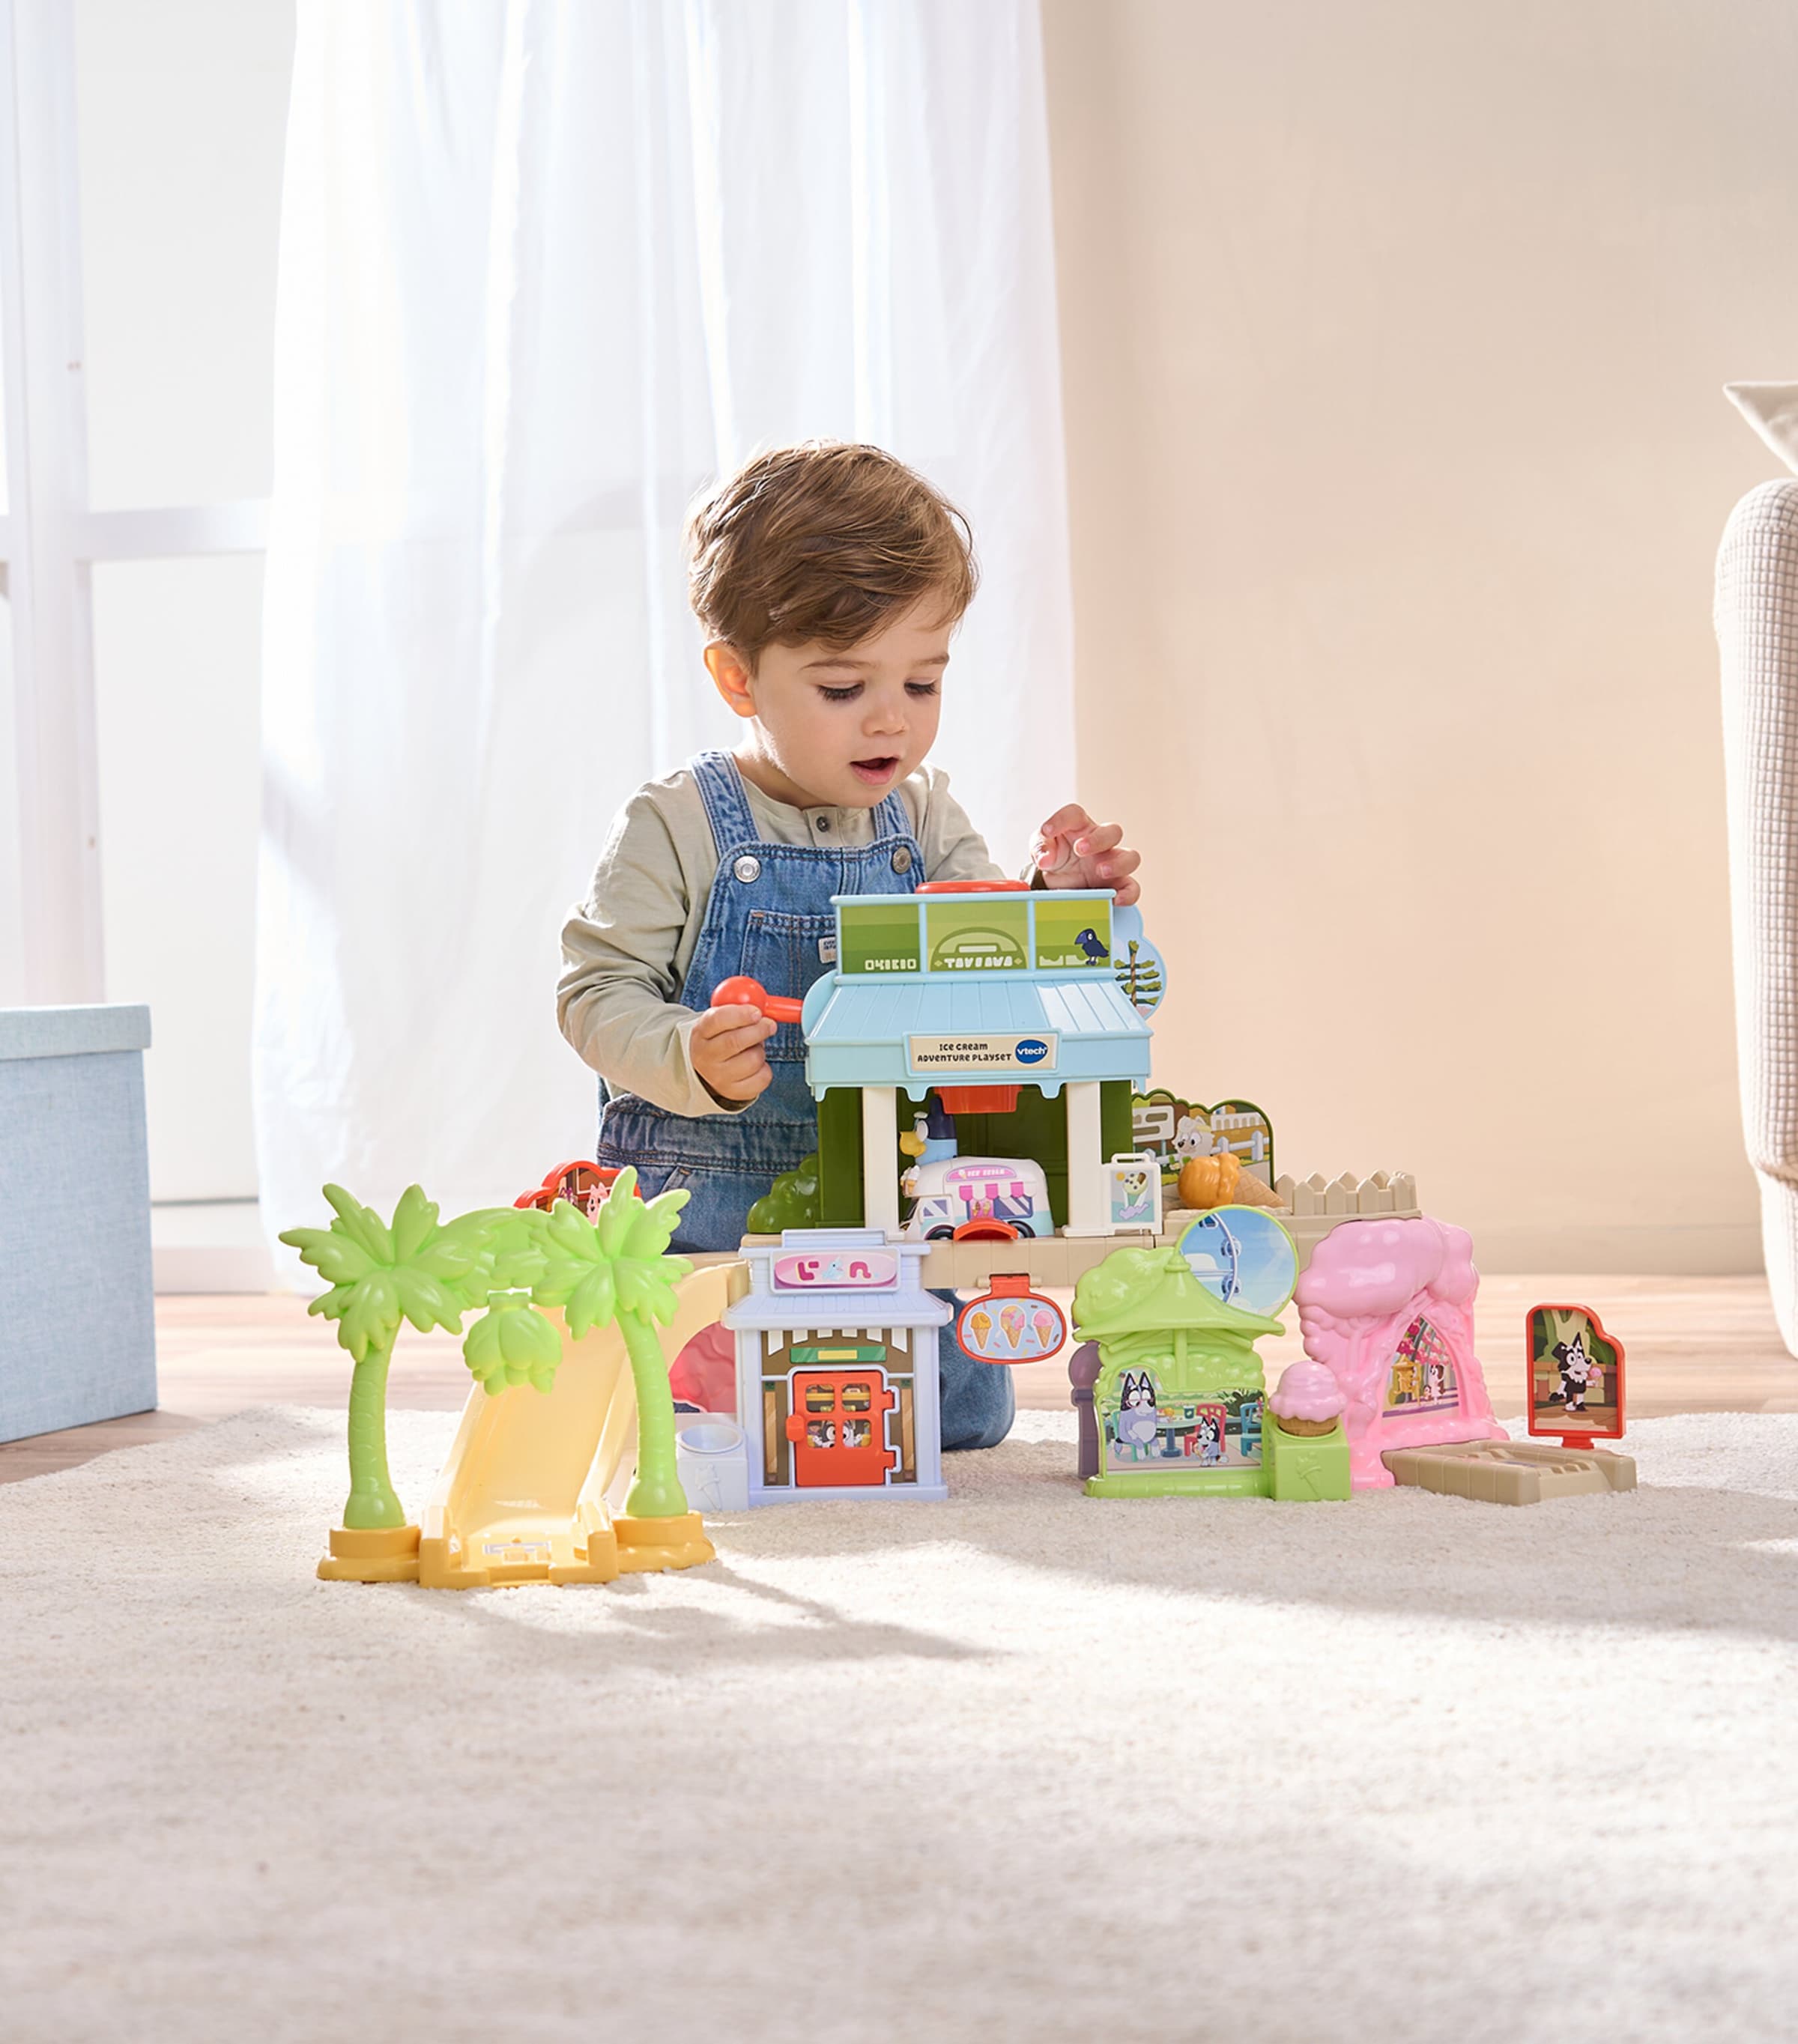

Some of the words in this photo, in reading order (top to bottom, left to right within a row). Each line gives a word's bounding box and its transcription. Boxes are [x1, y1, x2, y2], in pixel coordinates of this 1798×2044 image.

[956, 1043, 988, 1051] CREAM
[1017, 1047, 1046, 1055] vtech
[972, 1053, 1011, 1062] PLAYSET
